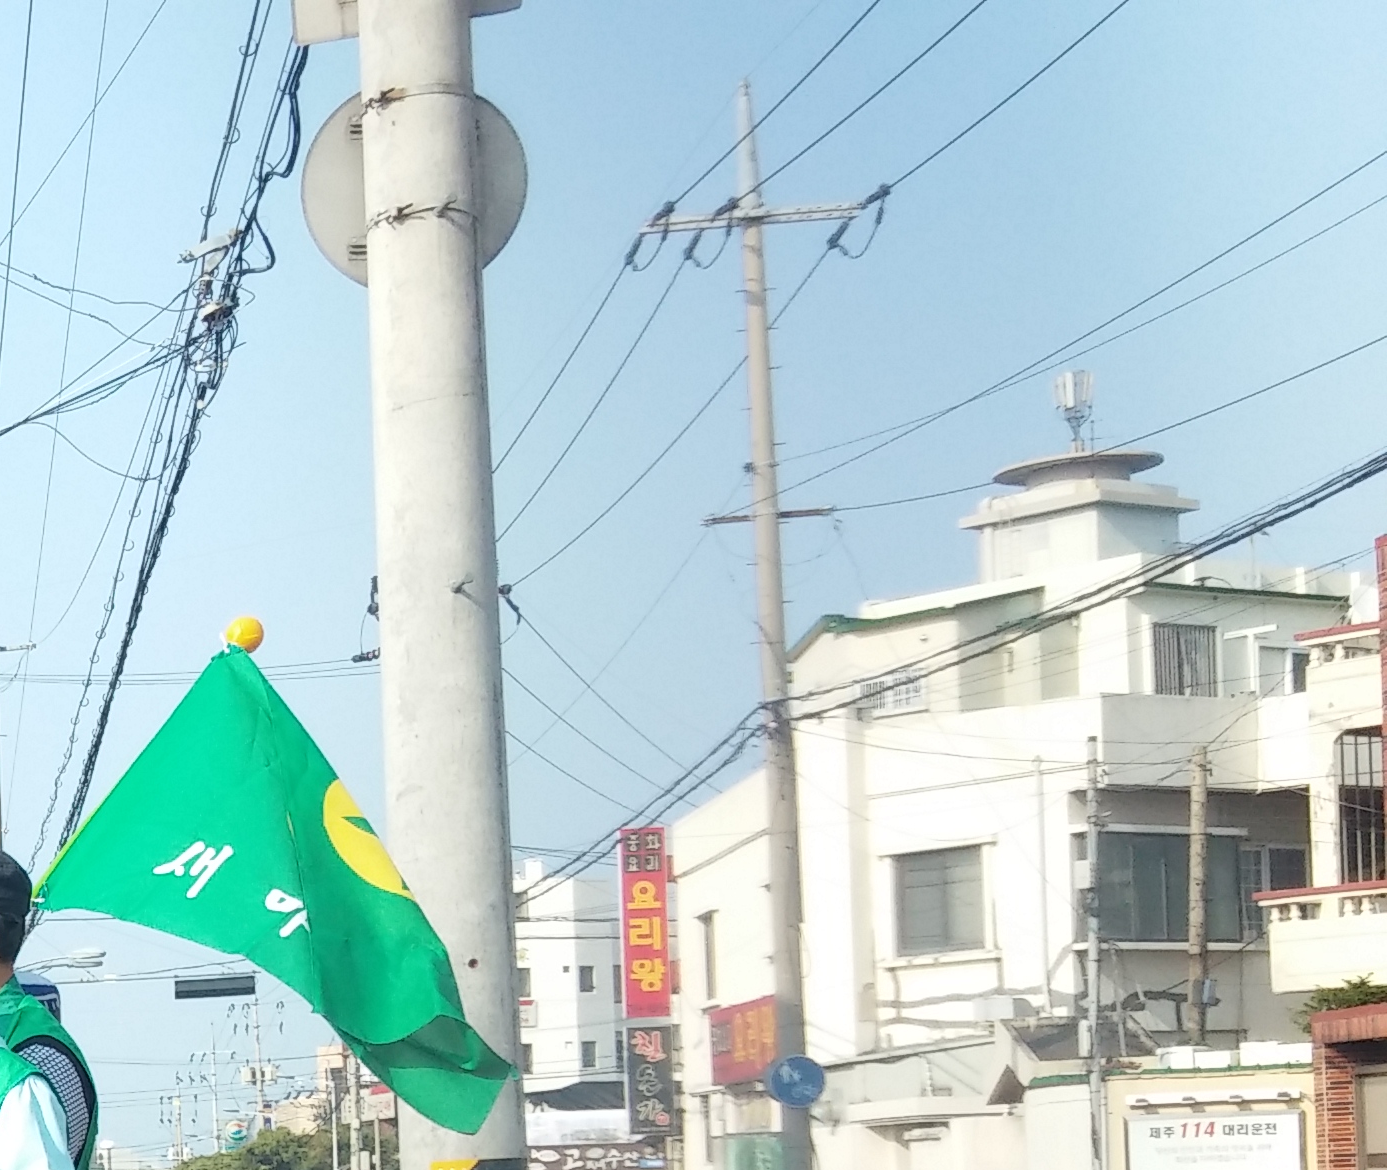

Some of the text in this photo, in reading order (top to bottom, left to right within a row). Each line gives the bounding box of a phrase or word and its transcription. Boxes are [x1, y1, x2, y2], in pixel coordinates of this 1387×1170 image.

[626, 879, 666, 993] 요리왕
[1149, 1121, 1278, 1139] 제주 114 대리운전
